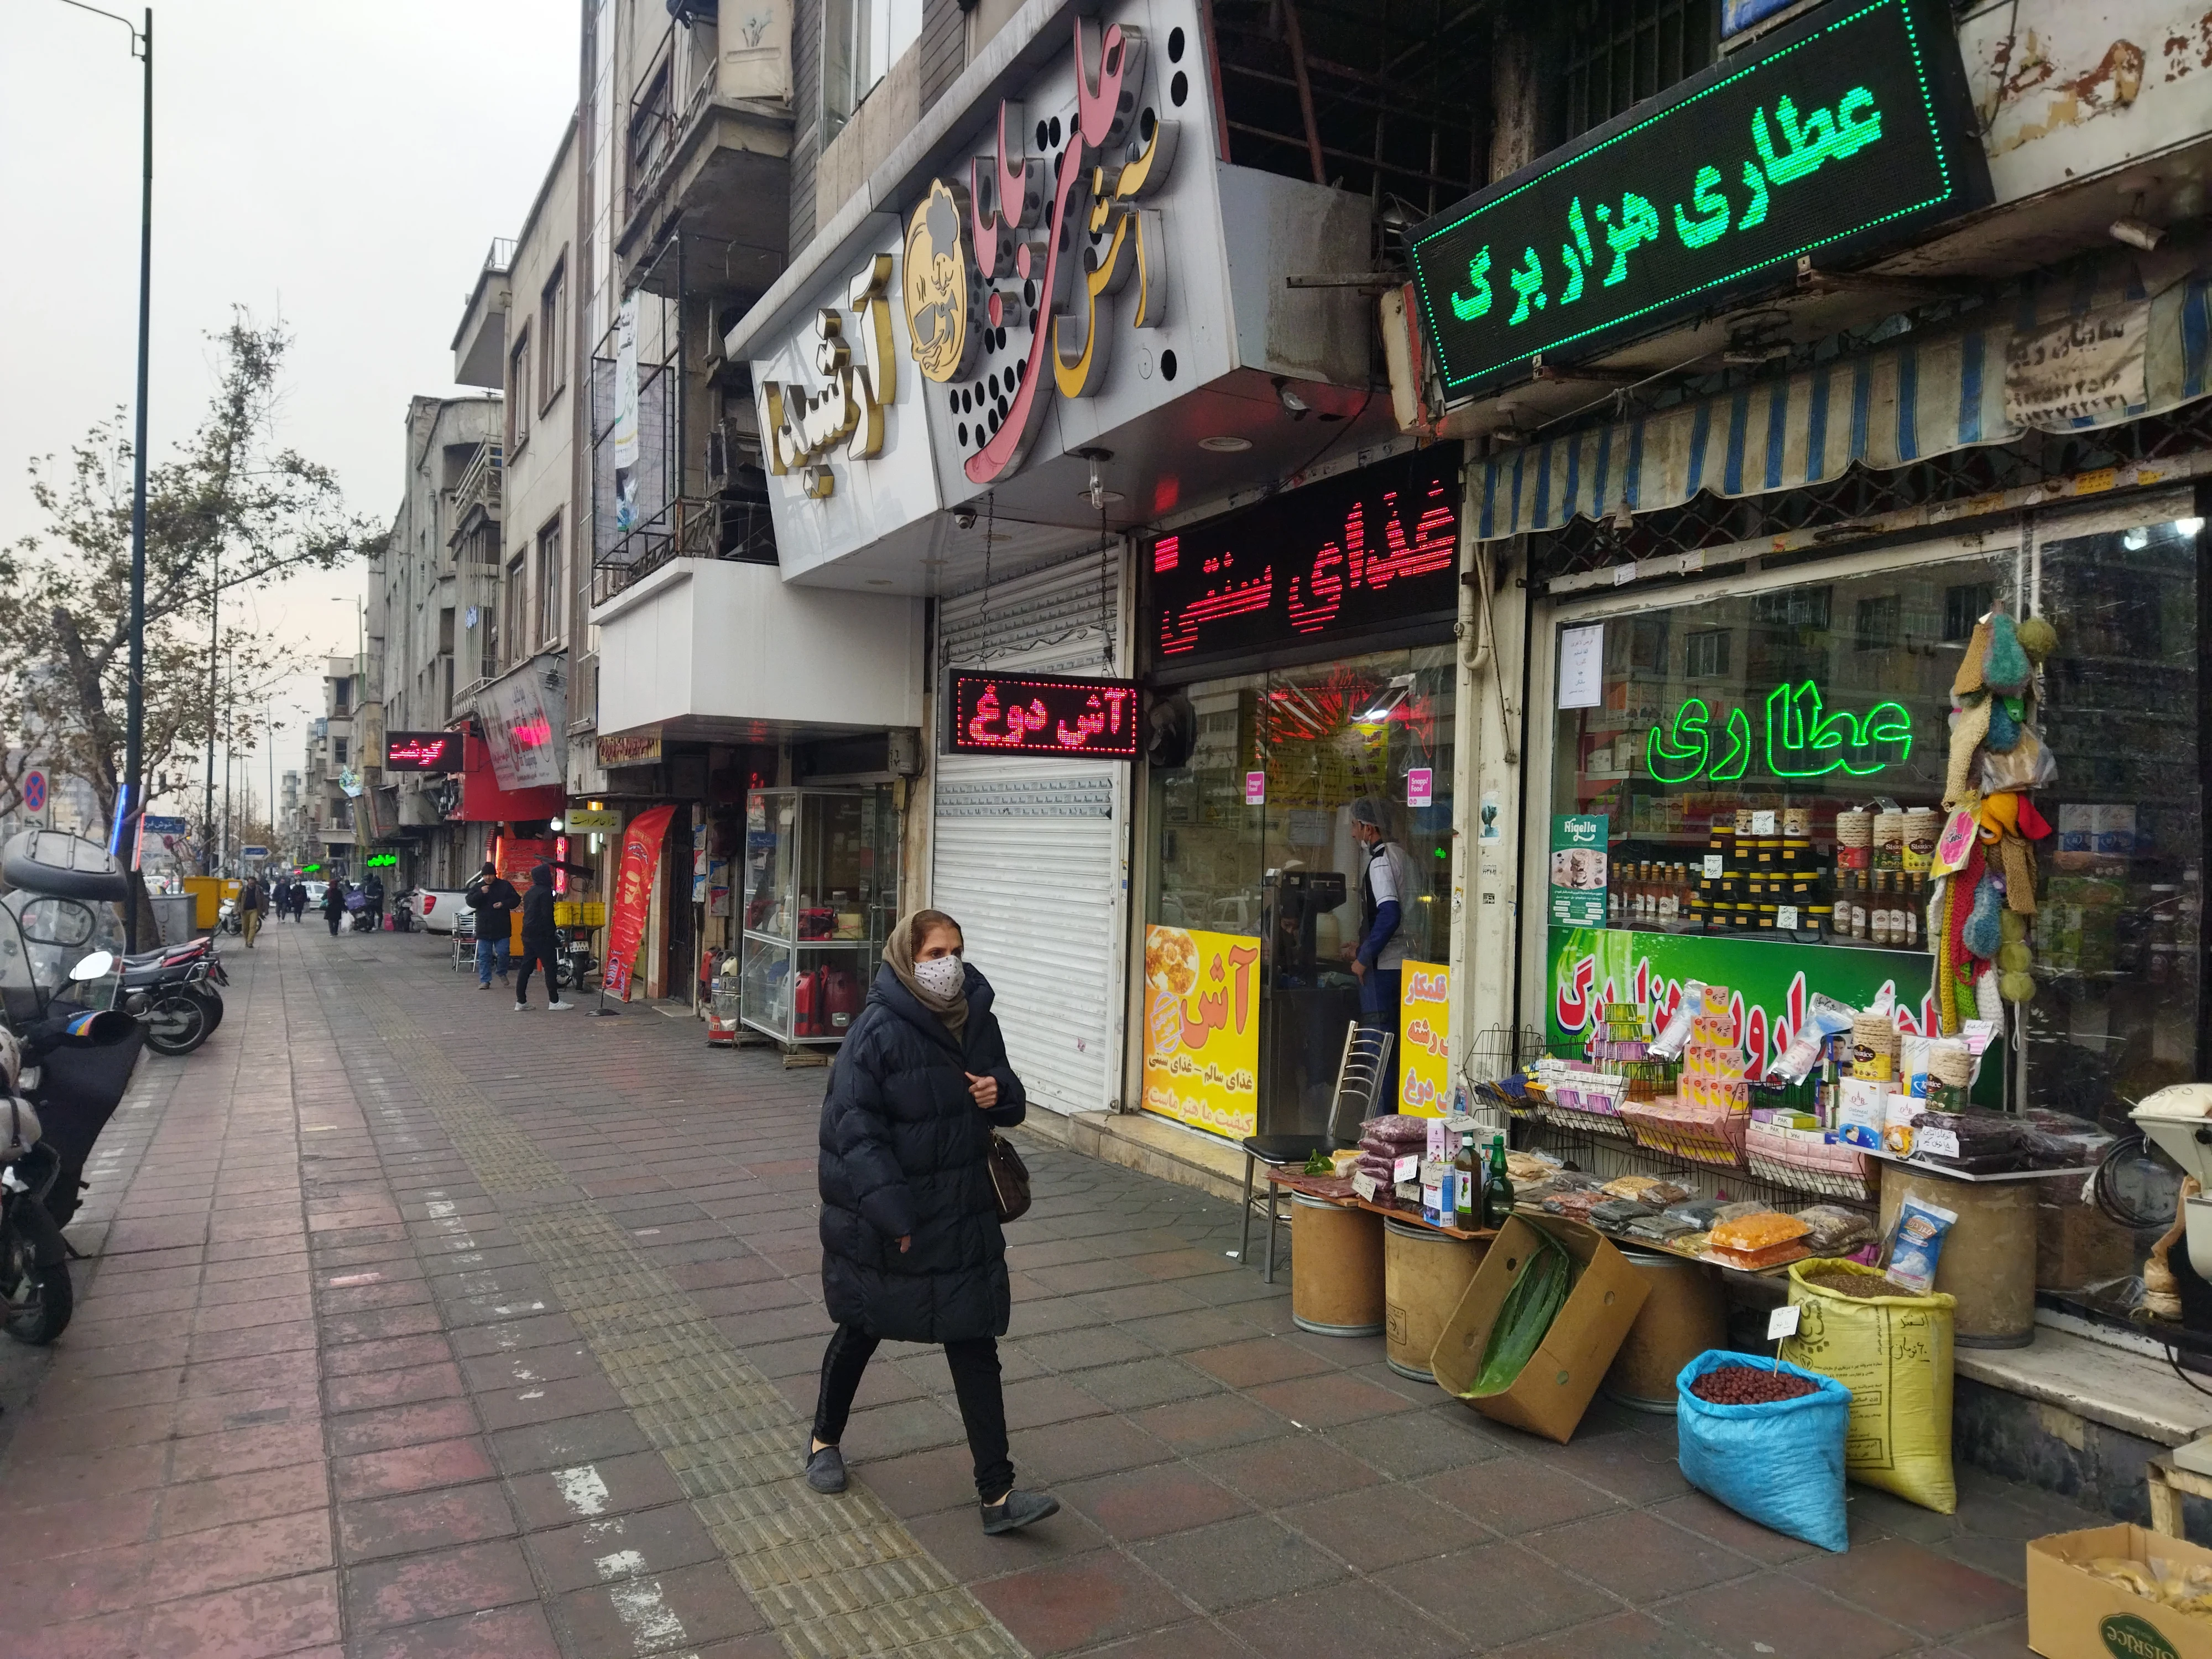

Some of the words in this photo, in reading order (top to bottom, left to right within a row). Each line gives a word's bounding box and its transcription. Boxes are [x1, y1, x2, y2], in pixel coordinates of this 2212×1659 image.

[1674, 85, 1882, 250] عطاری
[1053, 119, 1175, 398] آش
[1560, 191, 1660, 305] هزار
[1451, 244, 1547, 327] برگ
[758, 253, 896, 499] آرشیدا
[1287, 479, 1455, 634] غذای
[1161, 550, 1273, 656] سنتی
[968, 681, 1048, 744] دوغ
[1057, 686, 1129, 747] آش
[1647, 680, 1913, 783] عطاری
[1411, 777, 1428, 785] Snapp!
[589, 813, 607, 827] حاضر
[1564, 818, 1597, 842] Nigella
[1180, 944, 1258, 1049] آش
[1405, 973, 1447, 1004] قلمکار
[1407, 1019, 1437, 1054] رشته
[1149, 1052, 1168, 1067] سنتی
[1170, 1056, 1192, 1073] غذای
[1204, 1065, 1223, 1083] سالم
[1226, 1072, 1253, 1091] غذای
[1404, 1068, 1434, 1105] دوغ
[1150, 1090, 1178, 1109] ماست
[1180, 1100, 1199, 1118] هنر
[1202, 1102, 1212, 1121] ما
[1848, 1107, 1869, 1115] Oatmeal
[1851, 1091, 1865, 1104] OAB
[1900, 1103, 1913, 1115] OAB
[1215, 1112, 1253, 1139] کیفیت
